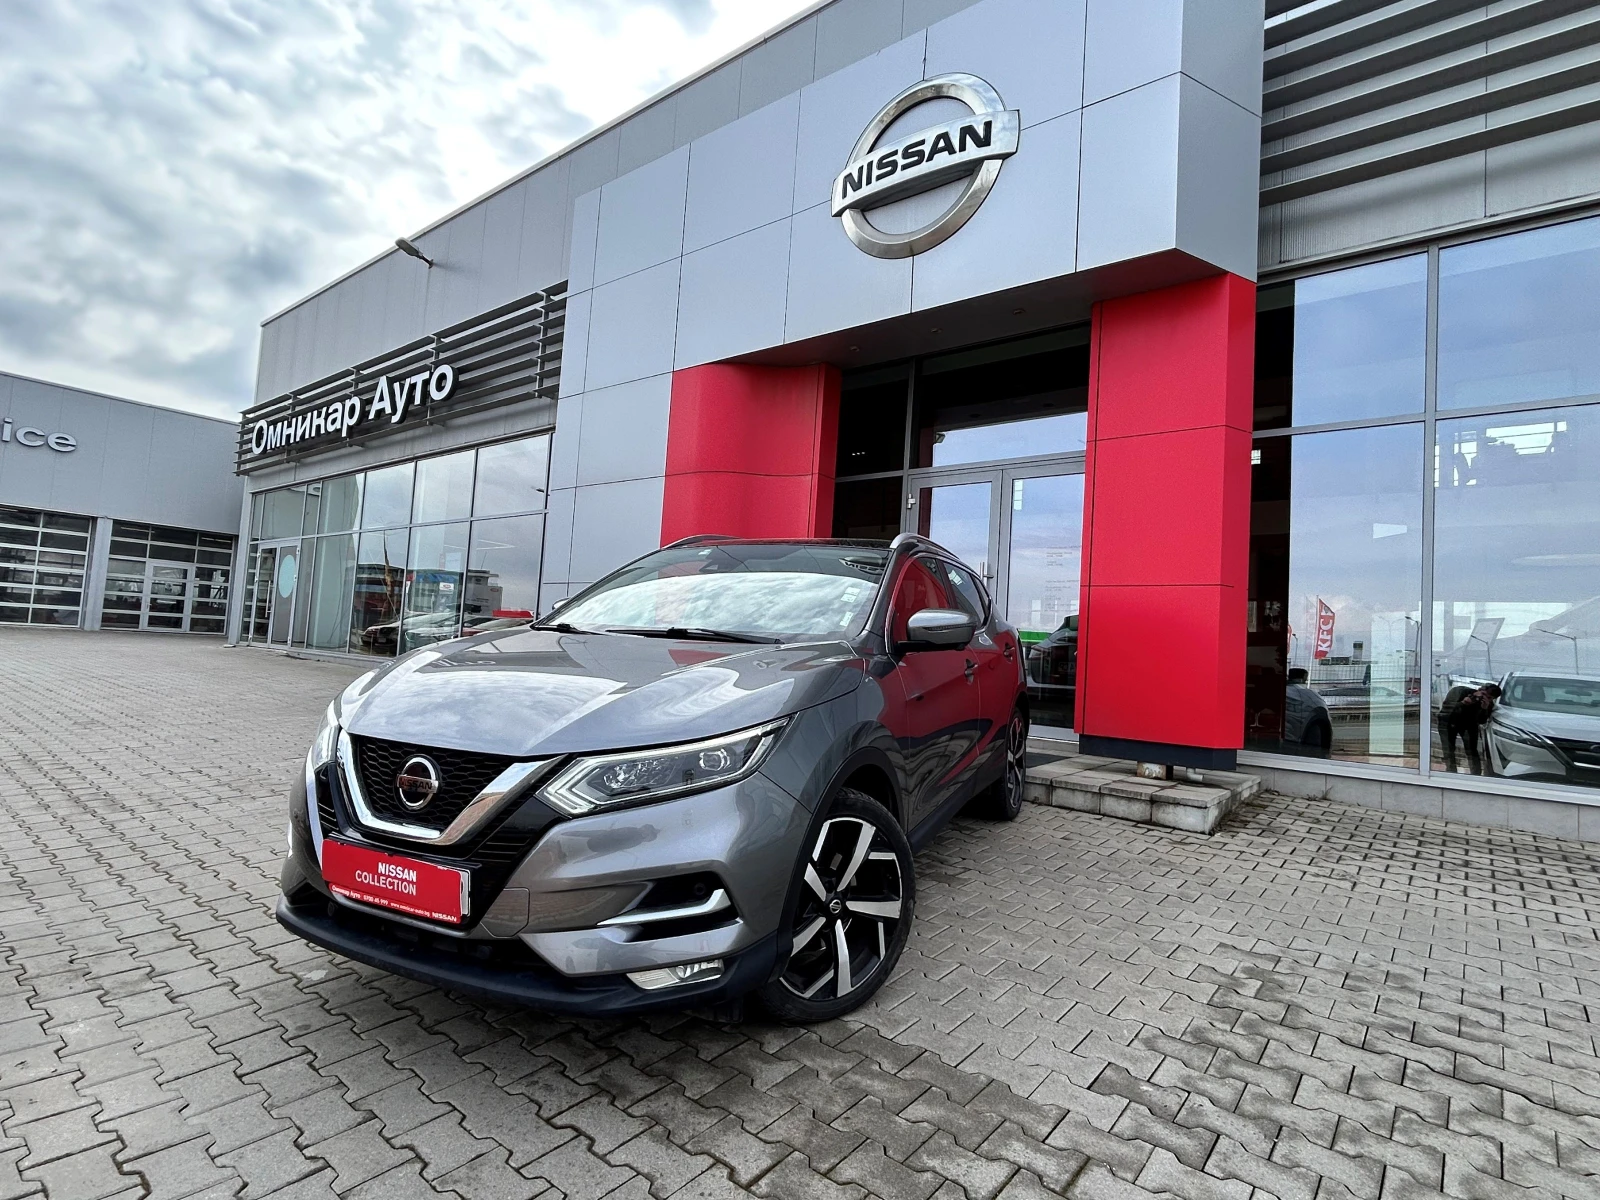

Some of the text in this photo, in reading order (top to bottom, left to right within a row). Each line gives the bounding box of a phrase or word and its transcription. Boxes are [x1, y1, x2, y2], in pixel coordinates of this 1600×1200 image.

[841, 120, 993, 200] NISSAN
[251, 364, 455, 455] Омникар Ауто
[1317, 618, 1333, 652] KFC
[400, 778, 433, 790] NISSAN
[355, 870, 416, 895] COLLECTION
[378, 862, 416, 882] NISSAN
[432, 911, 457, 922] NISSAN
